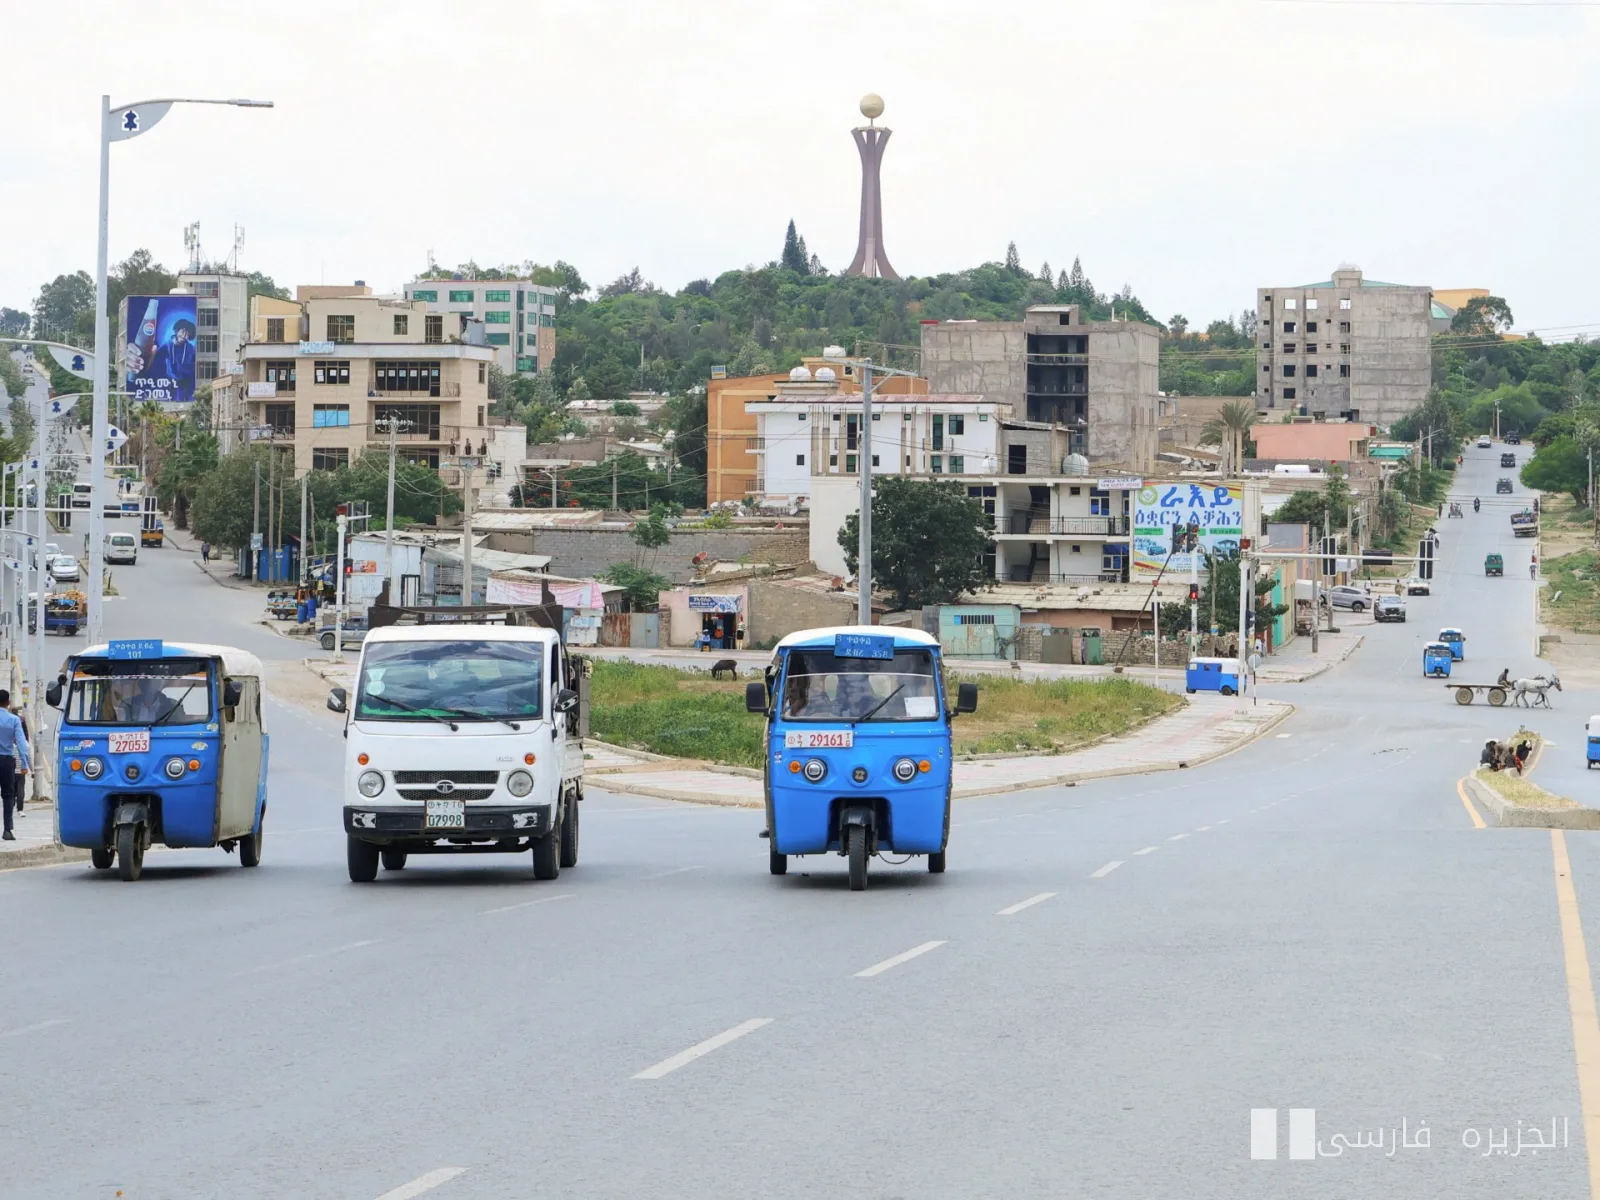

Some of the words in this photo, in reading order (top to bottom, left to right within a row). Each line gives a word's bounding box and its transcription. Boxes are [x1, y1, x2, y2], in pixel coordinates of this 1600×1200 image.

[1160, 484, 1233, 508] ራእይ
[127, 651, 142, 659] 101
[871, 649, 888, 658] 358
[115, 740, 148, 752] 27053
[809, 734, 843, 747] 29161
[428, 814, 462, 827] 07998
